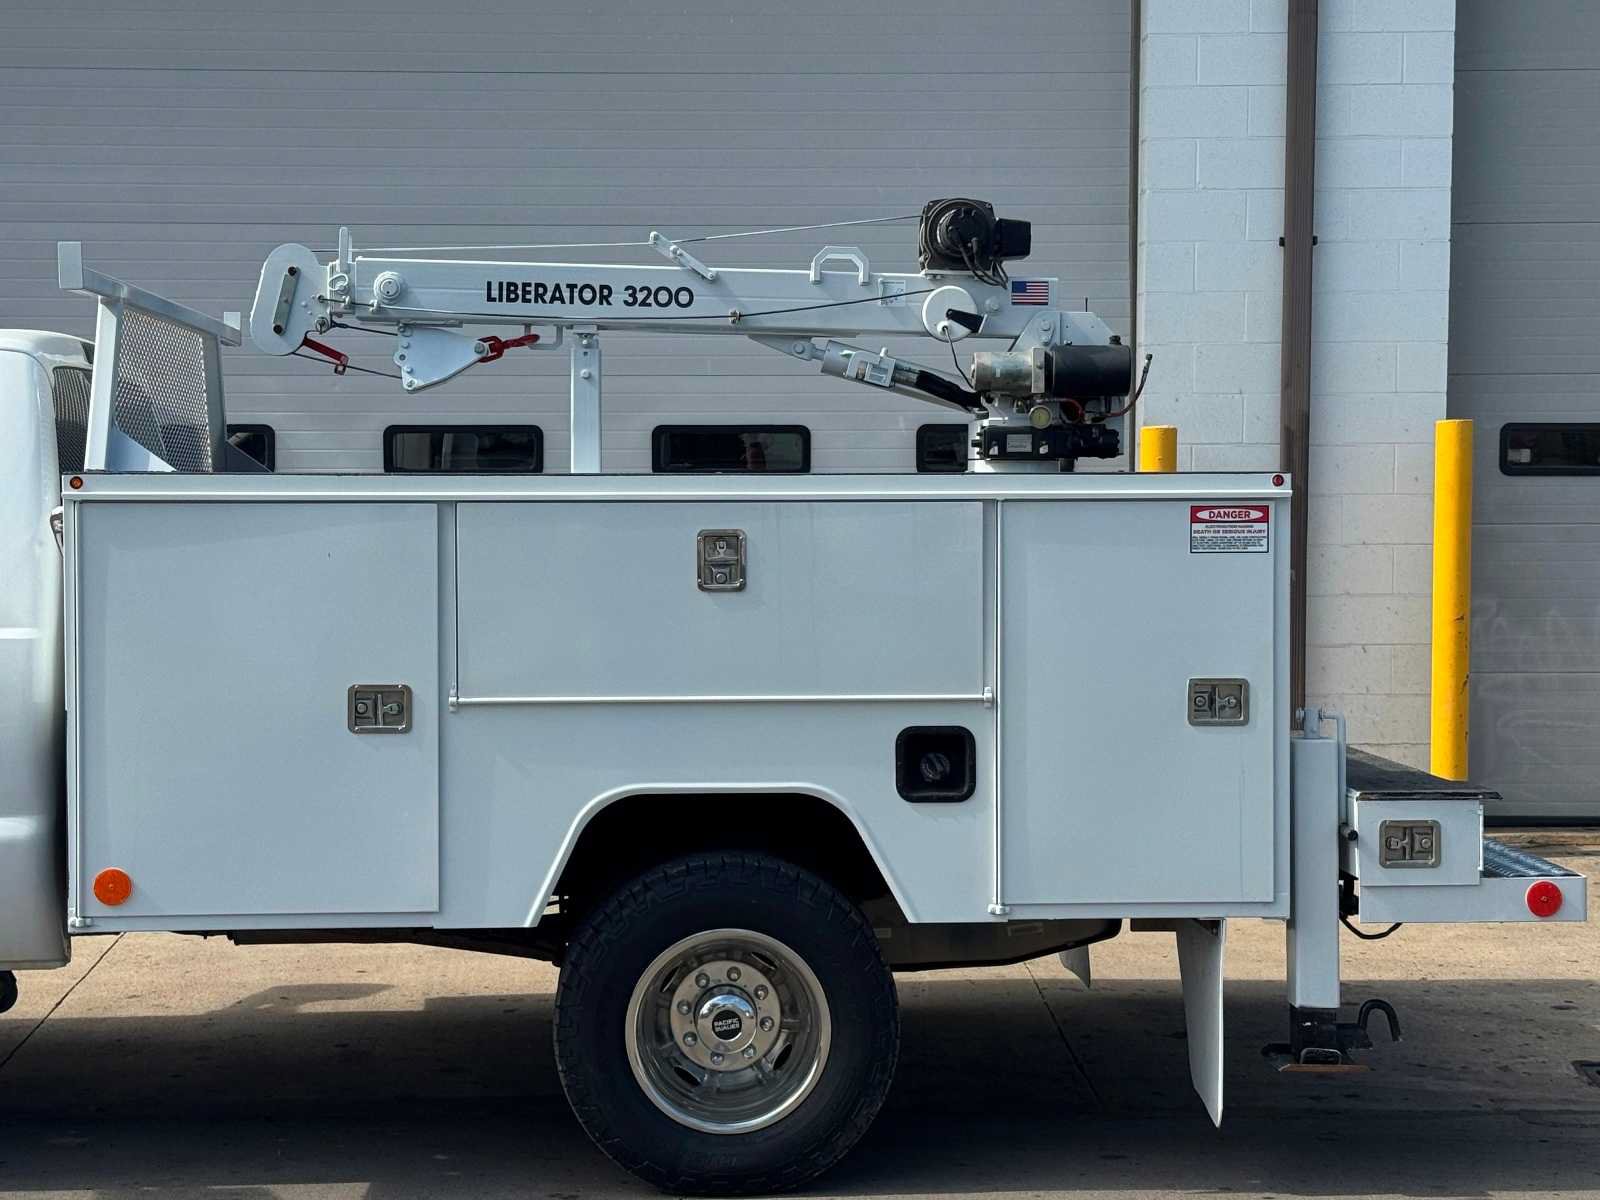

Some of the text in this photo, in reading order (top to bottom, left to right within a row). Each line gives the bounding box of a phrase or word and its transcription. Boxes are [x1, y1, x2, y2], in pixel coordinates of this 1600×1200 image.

[486, 281, 694, 308] LIBERATOR 3200
[1208, 511, 1251, 519] DANGER
